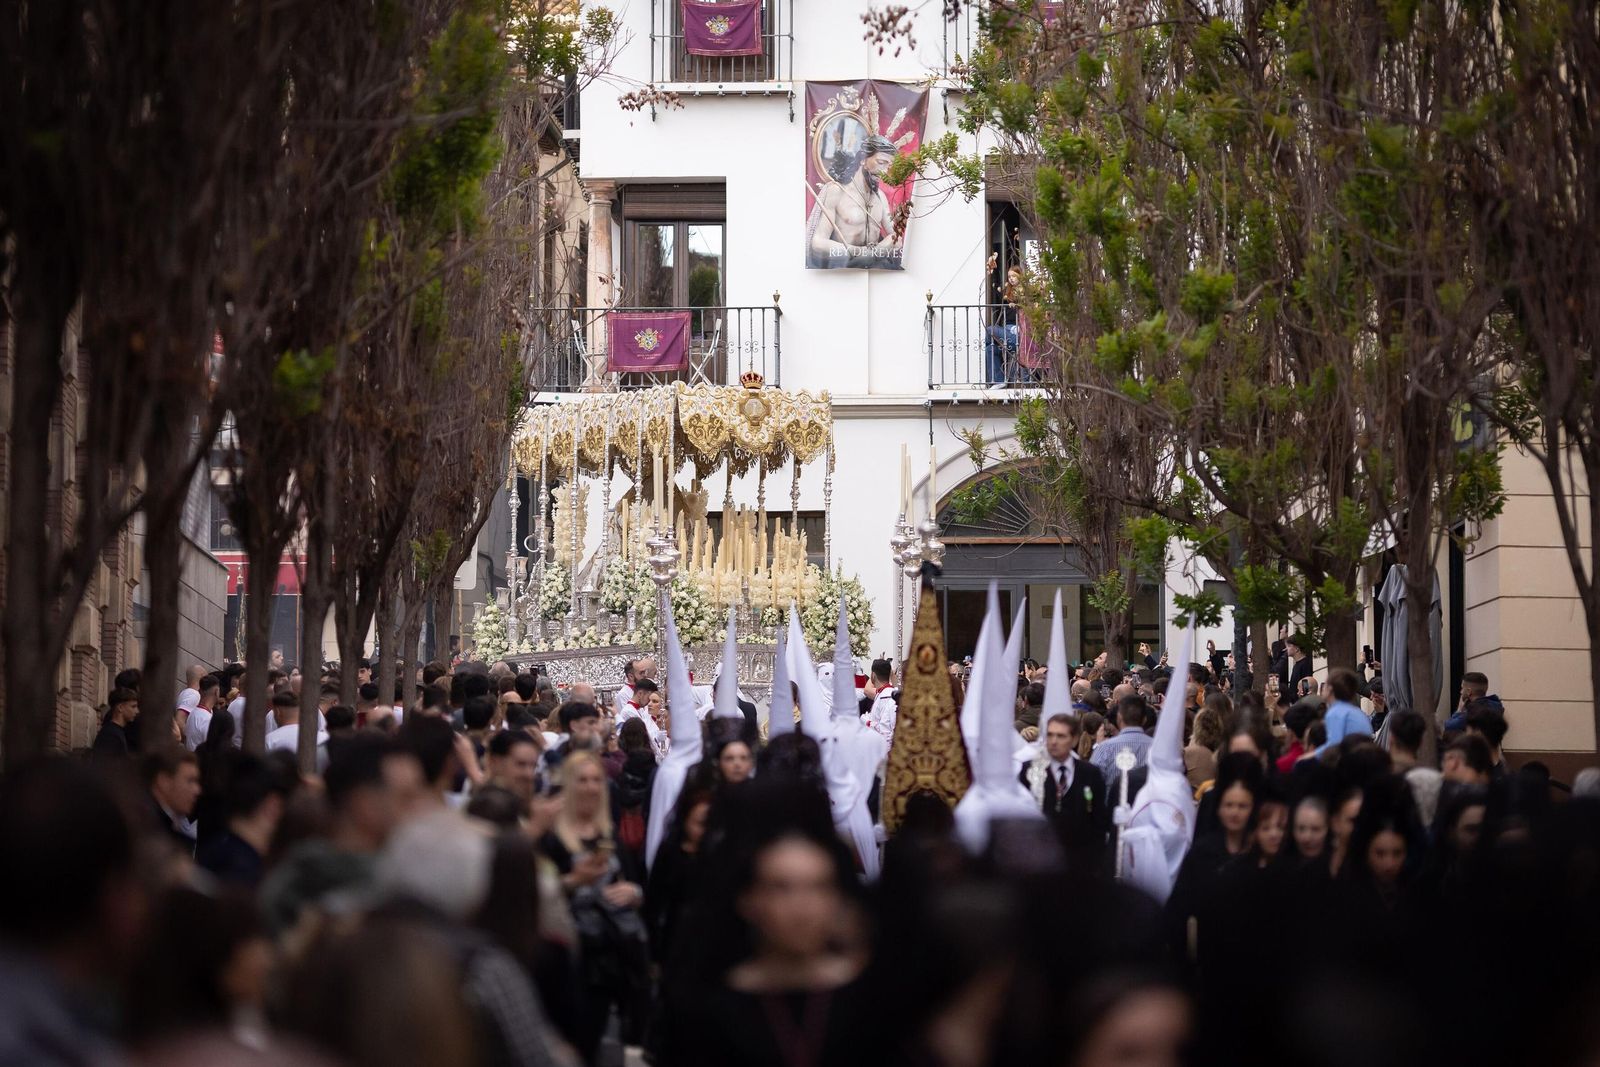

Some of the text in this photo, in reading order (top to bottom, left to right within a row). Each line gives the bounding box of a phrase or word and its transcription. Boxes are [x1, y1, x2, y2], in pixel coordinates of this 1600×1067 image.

[829, 247, 904, 258] REY DE REYES
